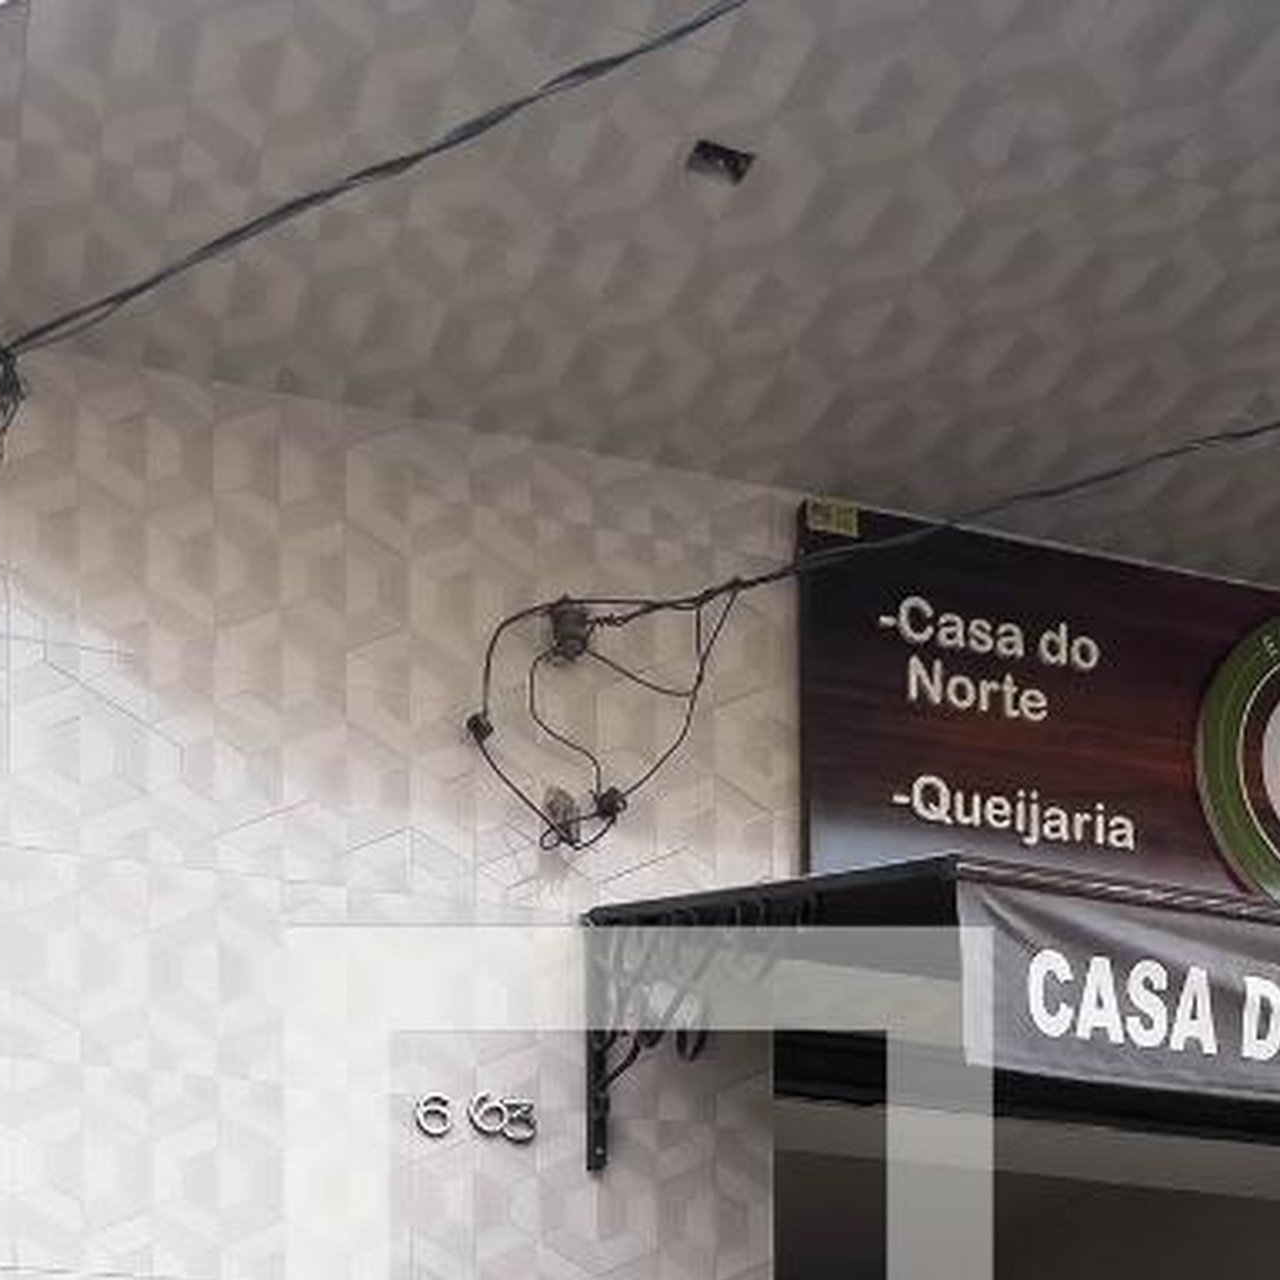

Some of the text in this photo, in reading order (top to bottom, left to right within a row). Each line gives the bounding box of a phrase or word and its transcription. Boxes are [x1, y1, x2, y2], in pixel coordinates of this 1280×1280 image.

[1040, 622, 1100, 670] do
[907, 655, 1048, 721] Norte
[1026, 948, 1218, 1056] CASA
